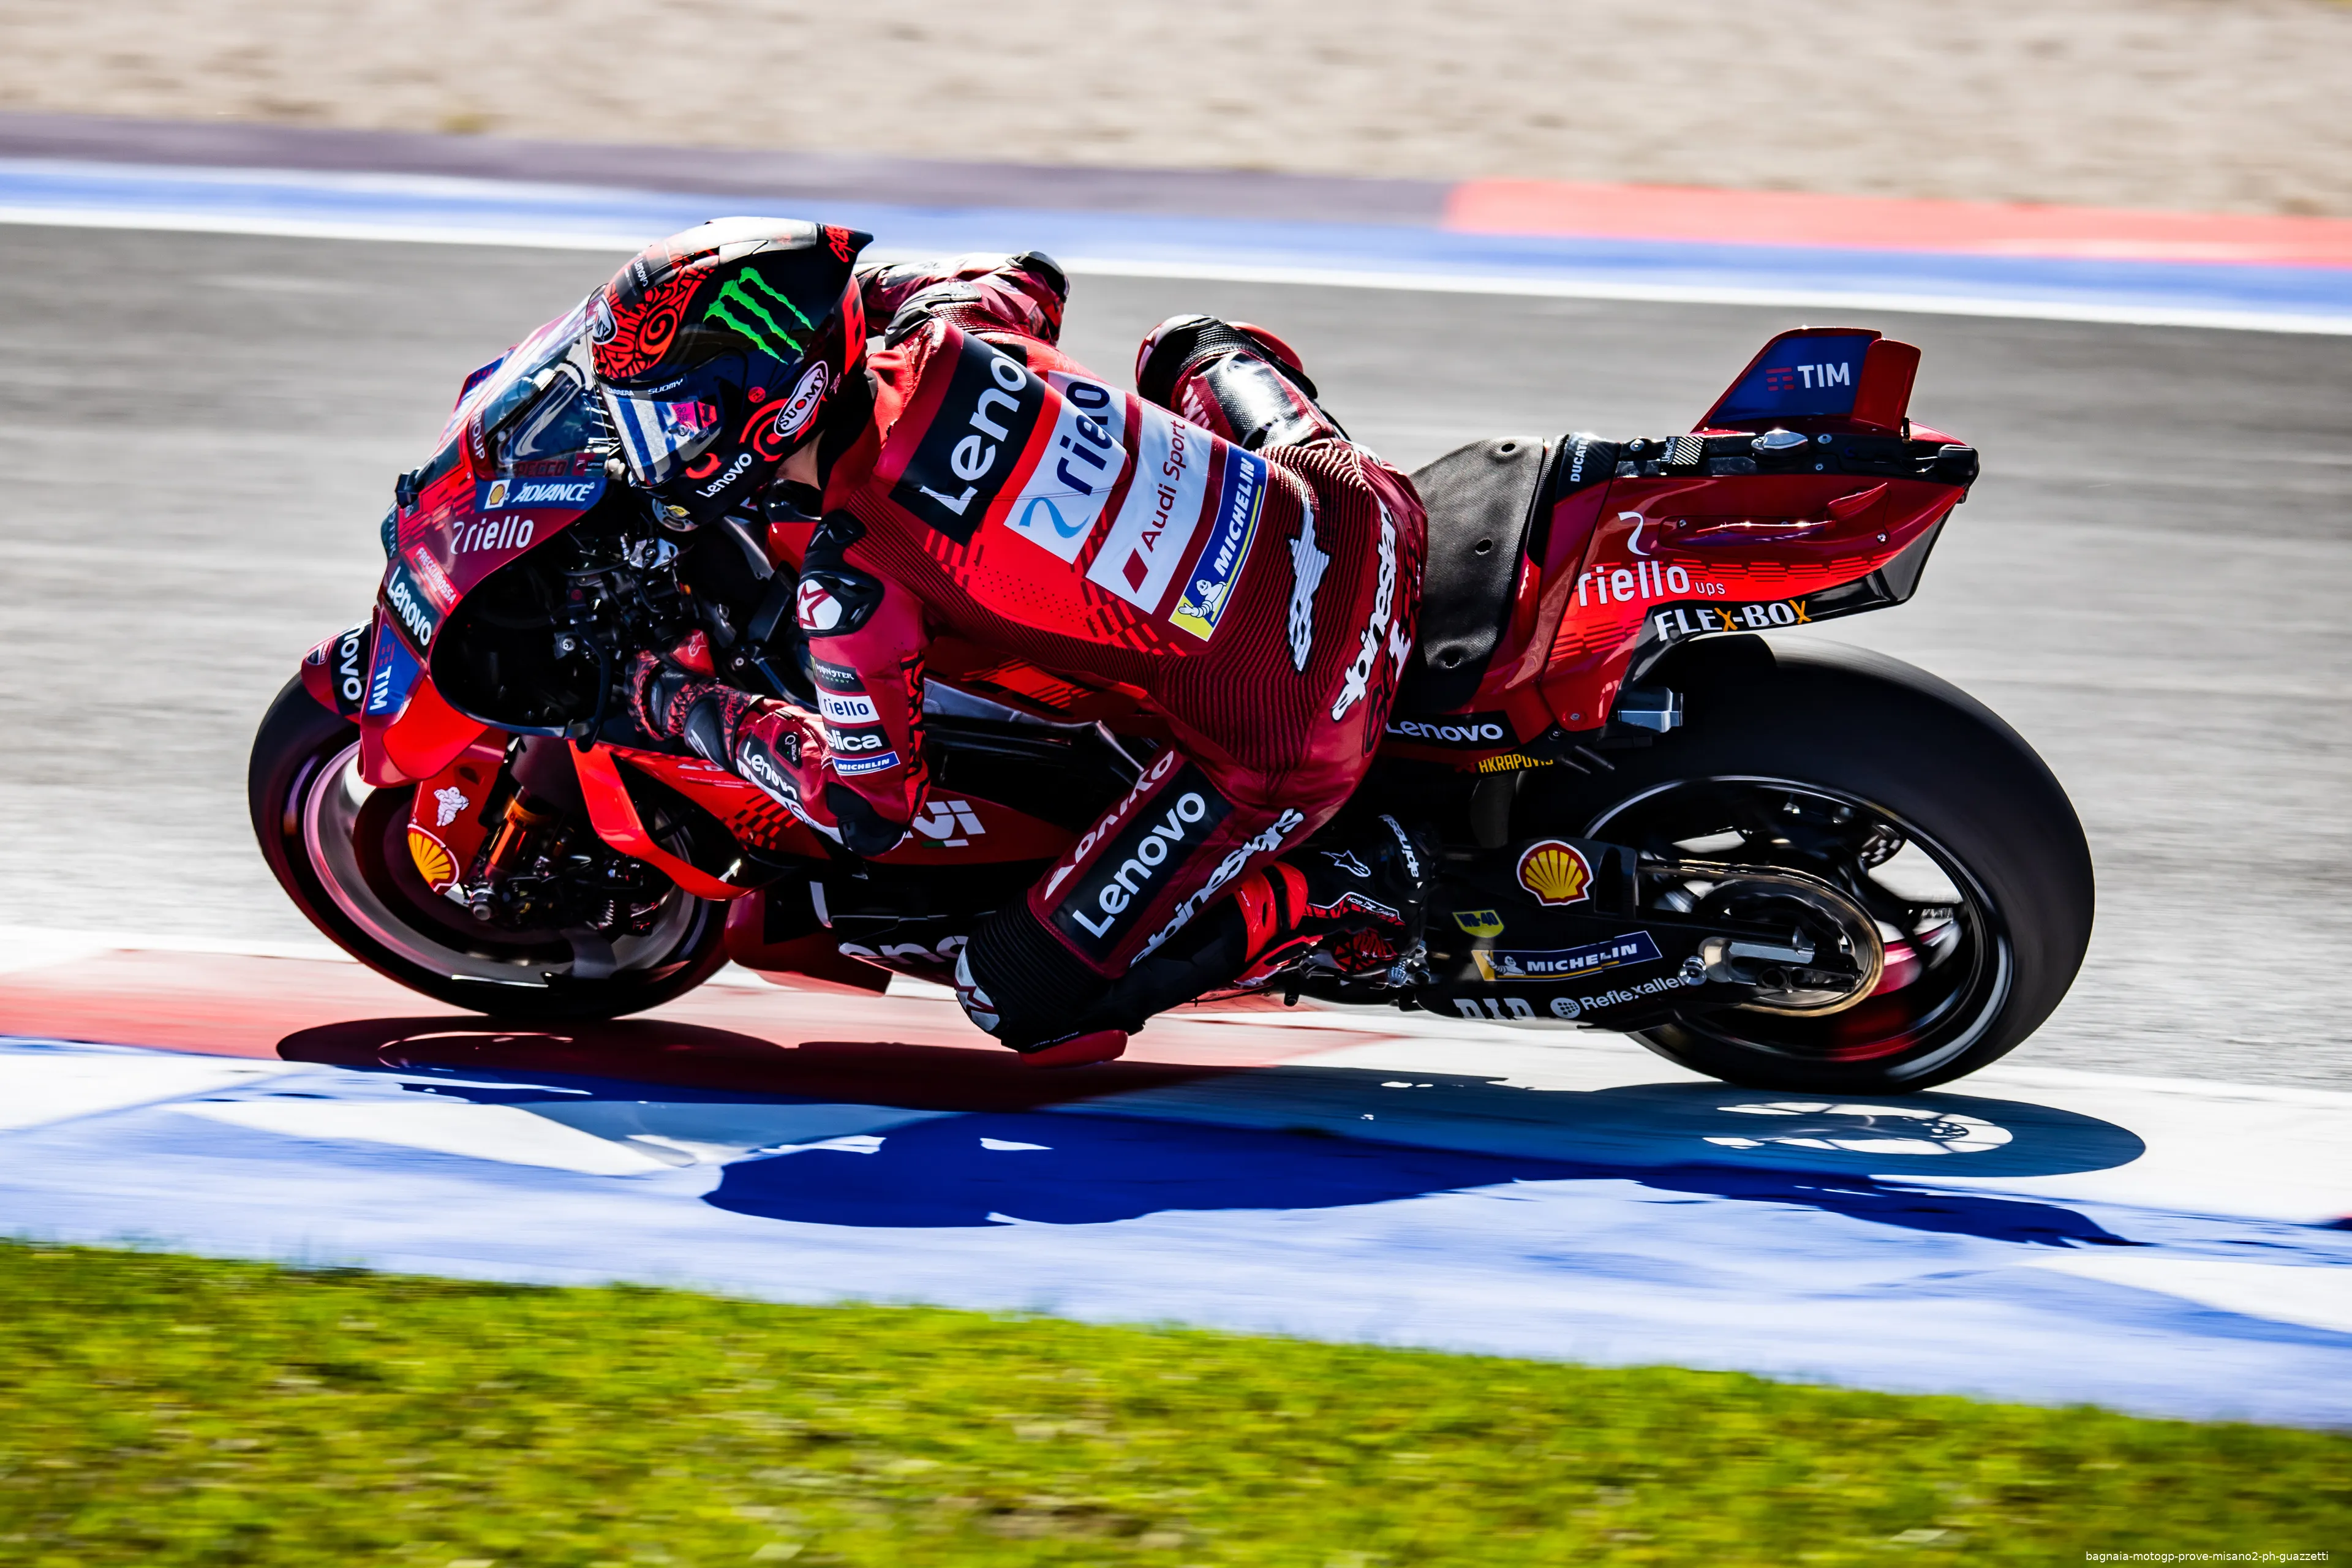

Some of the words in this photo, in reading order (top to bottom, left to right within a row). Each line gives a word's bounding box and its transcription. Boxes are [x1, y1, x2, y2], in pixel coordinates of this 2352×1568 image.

[647, 379, 683, 394] SUOMY
[1797, 363, 1850, 388] TIM
[778, 371, 826, 428] SUOMY
[919, 347, 1027, 516] Leno
[696, 453, 753, 498] Lenovo
[1570, 439, 1590, 482] DUCATI
[511, 482, 595, 503] ADVANCE
[1140, 483, 1177, 553] Audi
[1163, 420, 1186, 486] Sport
[462, 515, 535, 554] riello
[1213, 457, 1257, 578] MICHELIN
[416, 547, 457, 605] FRECCIAROSSA
[1577, 560, 1691, 607] riello
[1695, 581, 1726, 597] ups
[386, 565, 432, 646] Lenovo
[1654, 600, 1812, 641] FLEX-BOX
[340, 625, 366, 701] novo
[815, 663, 854, 680] MONSTER
[369, 665, 393, 710] TIM
[823, 698, 870, 717] riello
[826, 728, 883, 752] elica
[1385, 720, 1504, 742] Lenovo
[838, 758, 890, 771] MICHELIN
[1072, 792, 1206, 939] Lenovo
[1456, 911, 1500, 928] WD-40
[1526, 943, 1638, 973] MICHELIN
